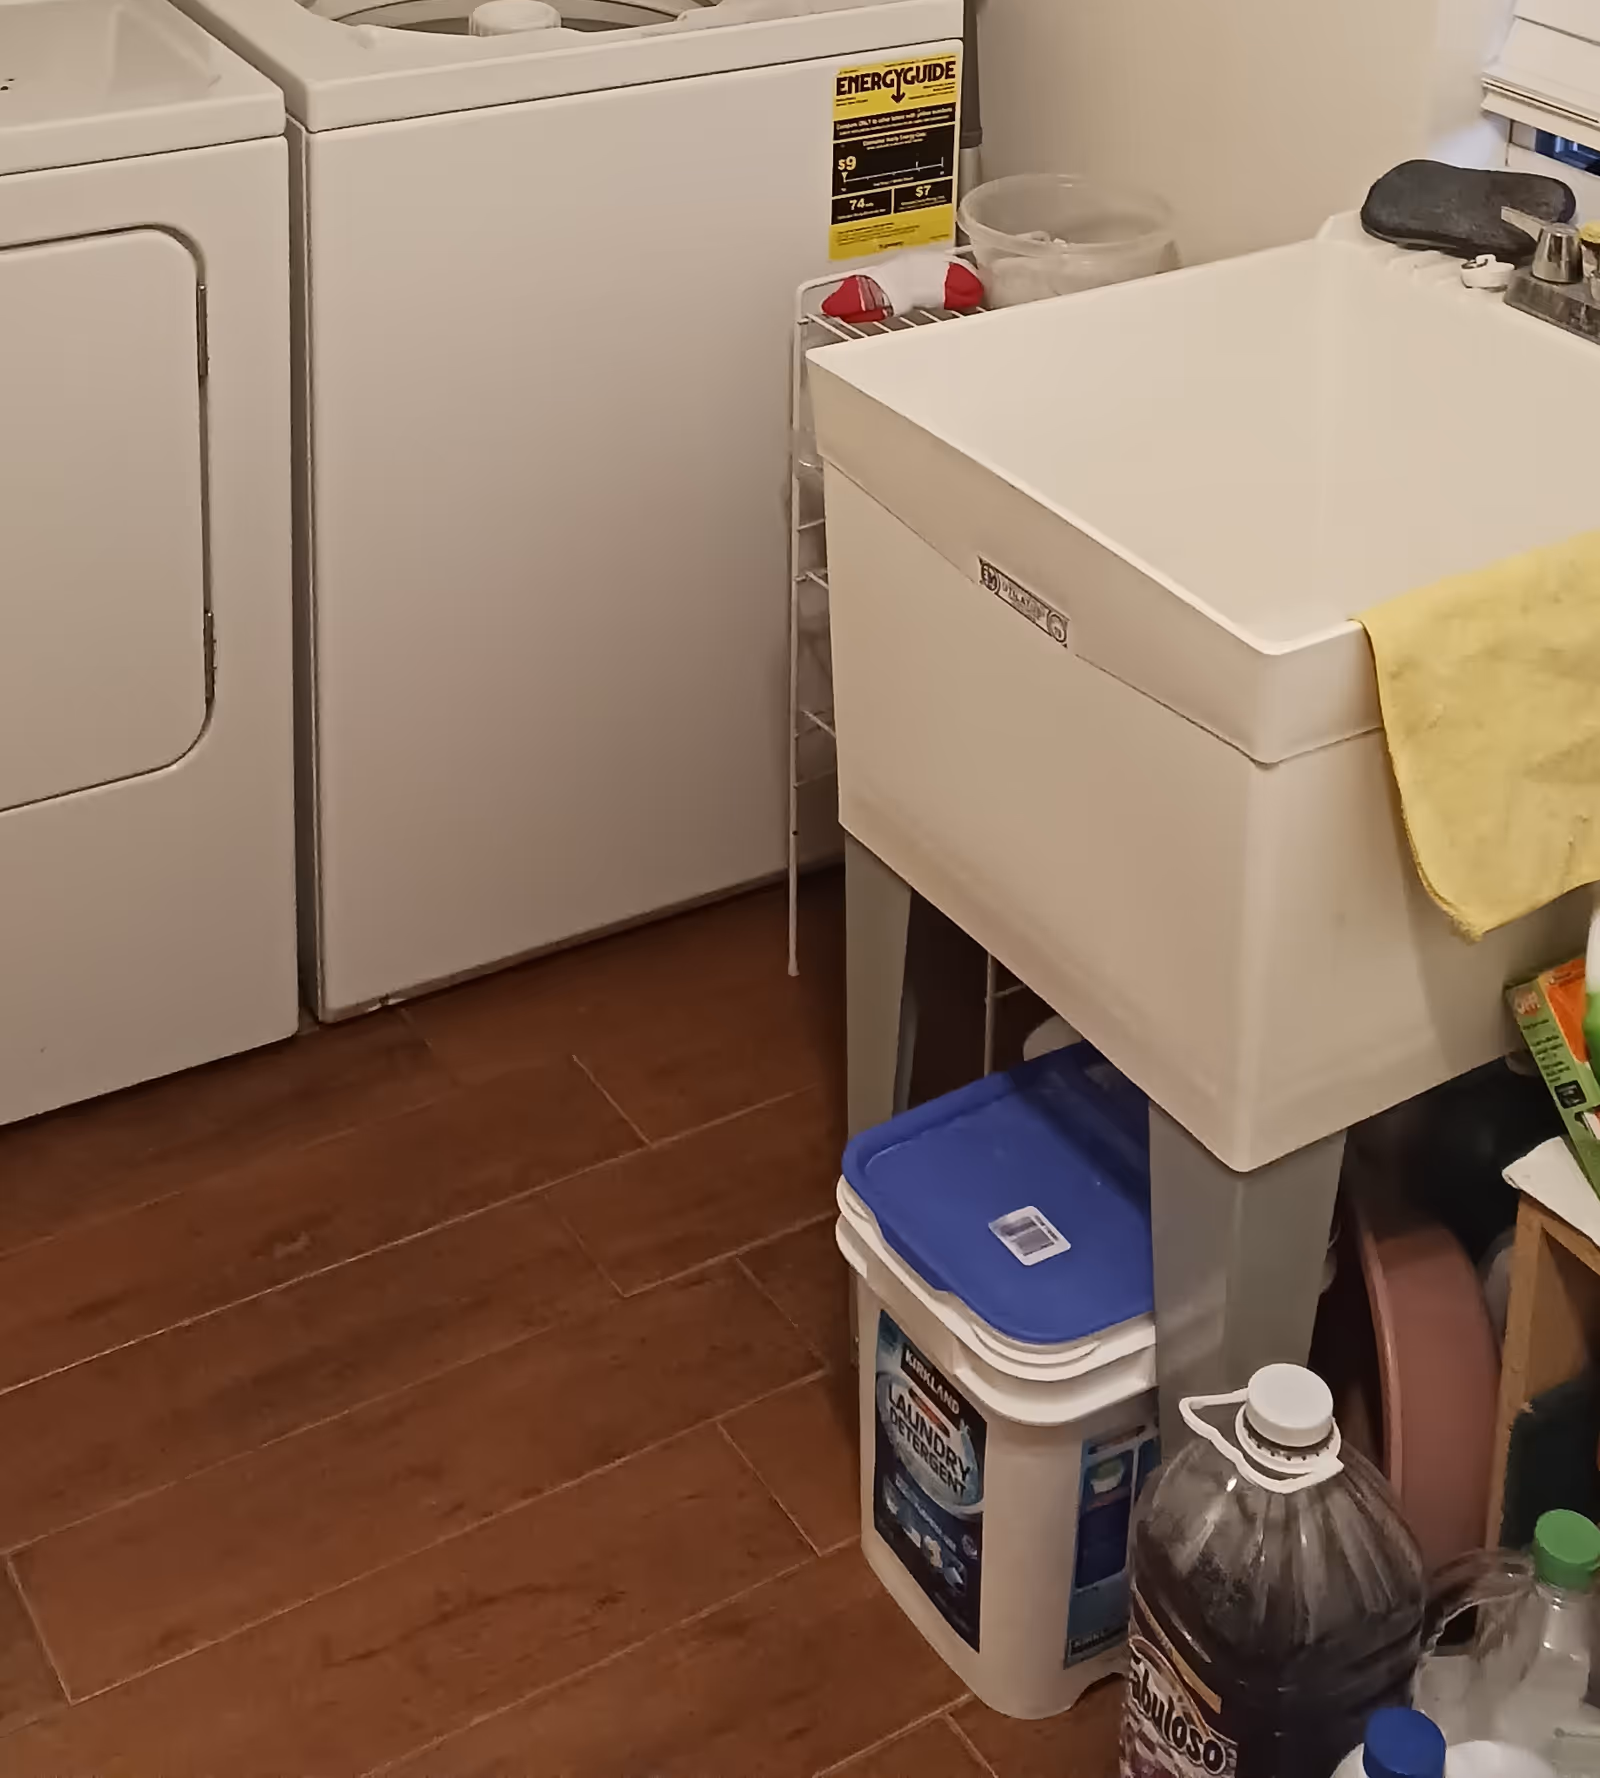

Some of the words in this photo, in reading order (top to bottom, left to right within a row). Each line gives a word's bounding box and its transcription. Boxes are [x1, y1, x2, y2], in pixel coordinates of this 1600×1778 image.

[836, 60, 957, 97] ENERGYGUIDE
[837, 155, 857, 171] $9
[849, 197, 865, 211] 74
[915, 185, 932, 198] $7
[904, 1348, 961, 1415] KIRKLAND
[888, 1383, 971, 1482] LAUNDRY
[889, 1406, 967, 1497] DETERGENT
